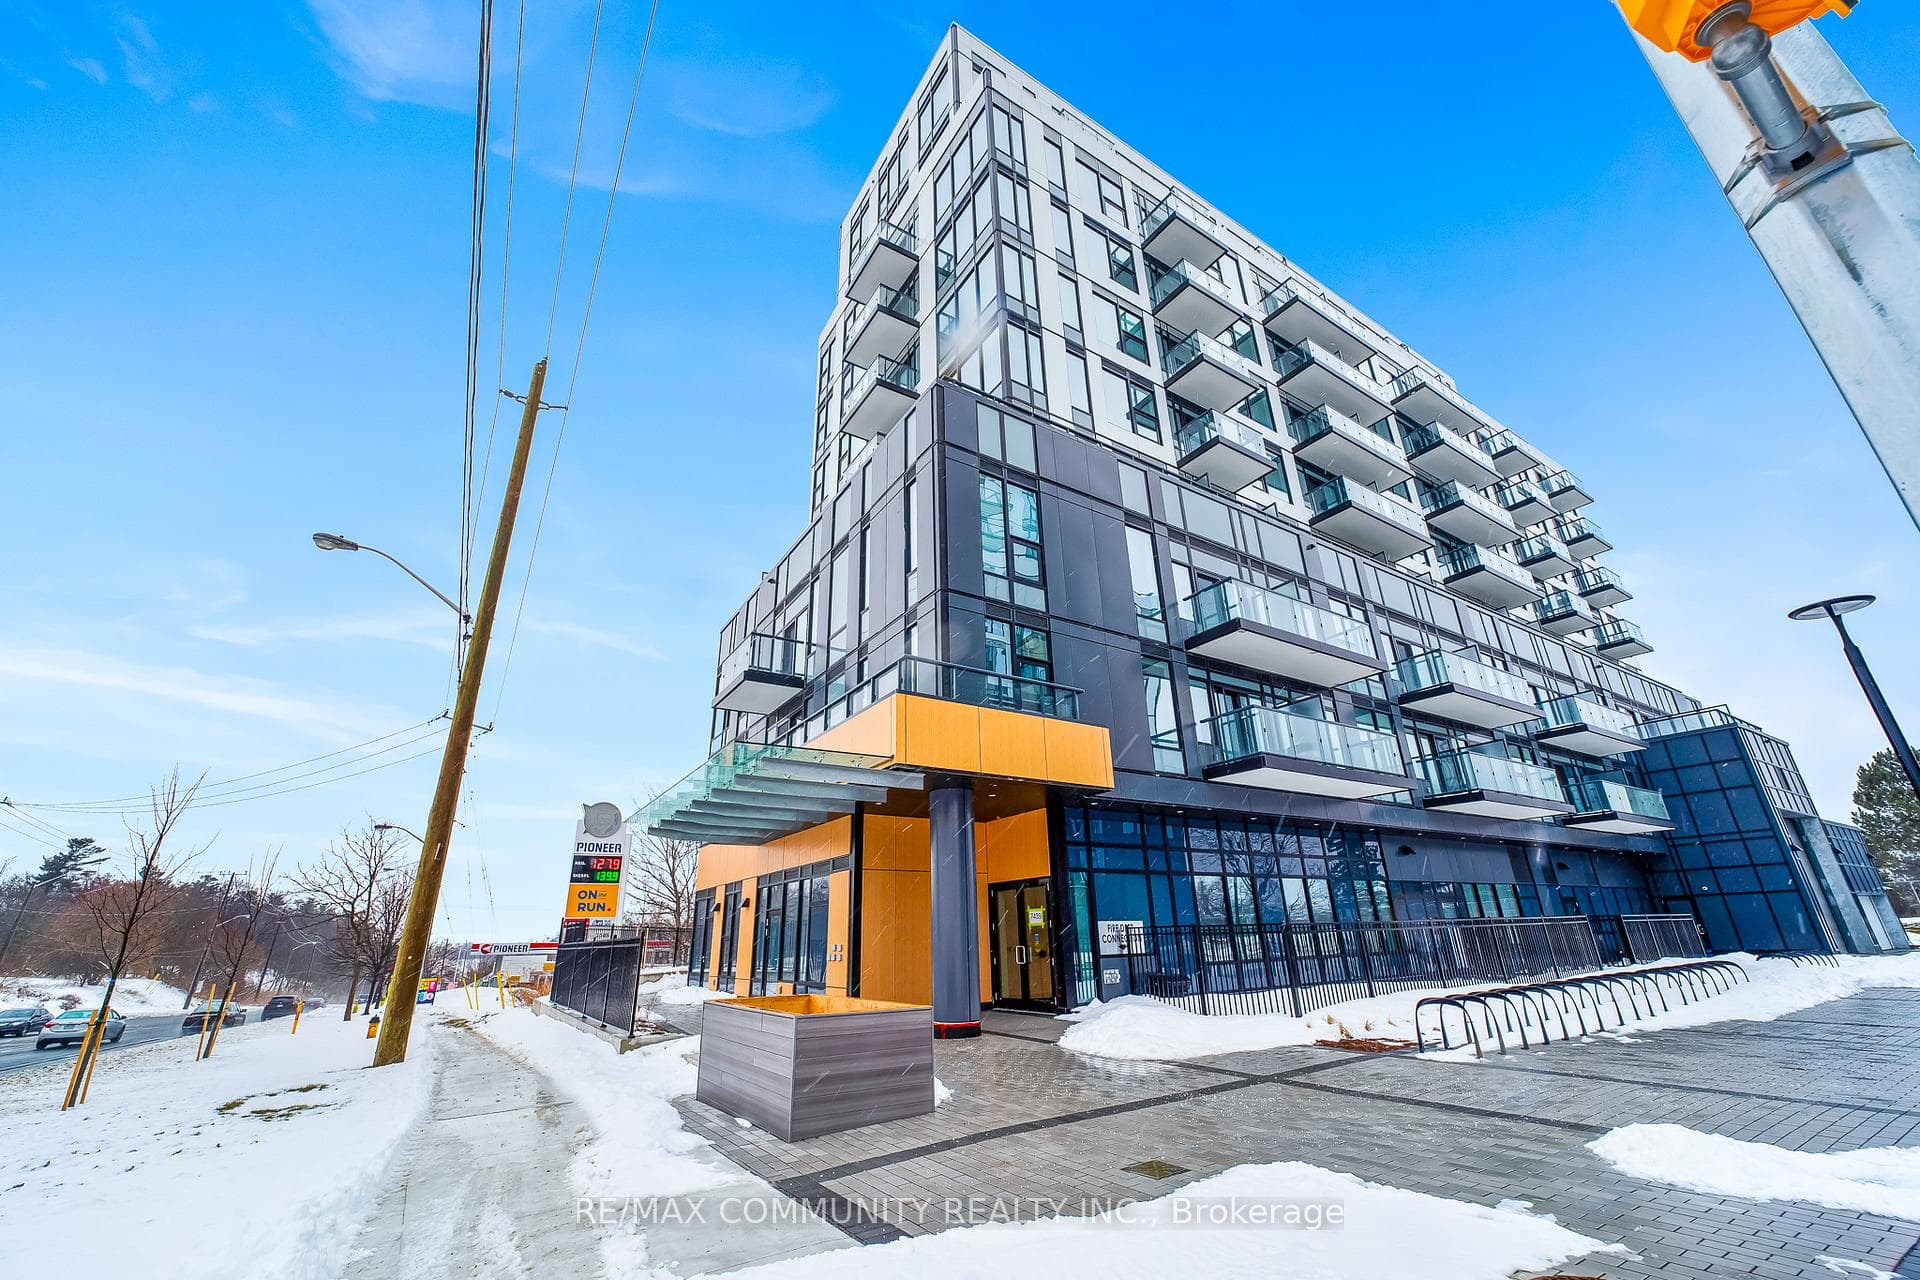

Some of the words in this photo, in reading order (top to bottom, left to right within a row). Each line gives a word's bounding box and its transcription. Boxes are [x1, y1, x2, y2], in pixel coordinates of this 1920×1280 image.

[576, 842, 622, 853] PIONEER
[577, 890, 598, 899] ON
[577, 902, 606, 912] RUN
[493, 944, 528, 953] PIONEER
